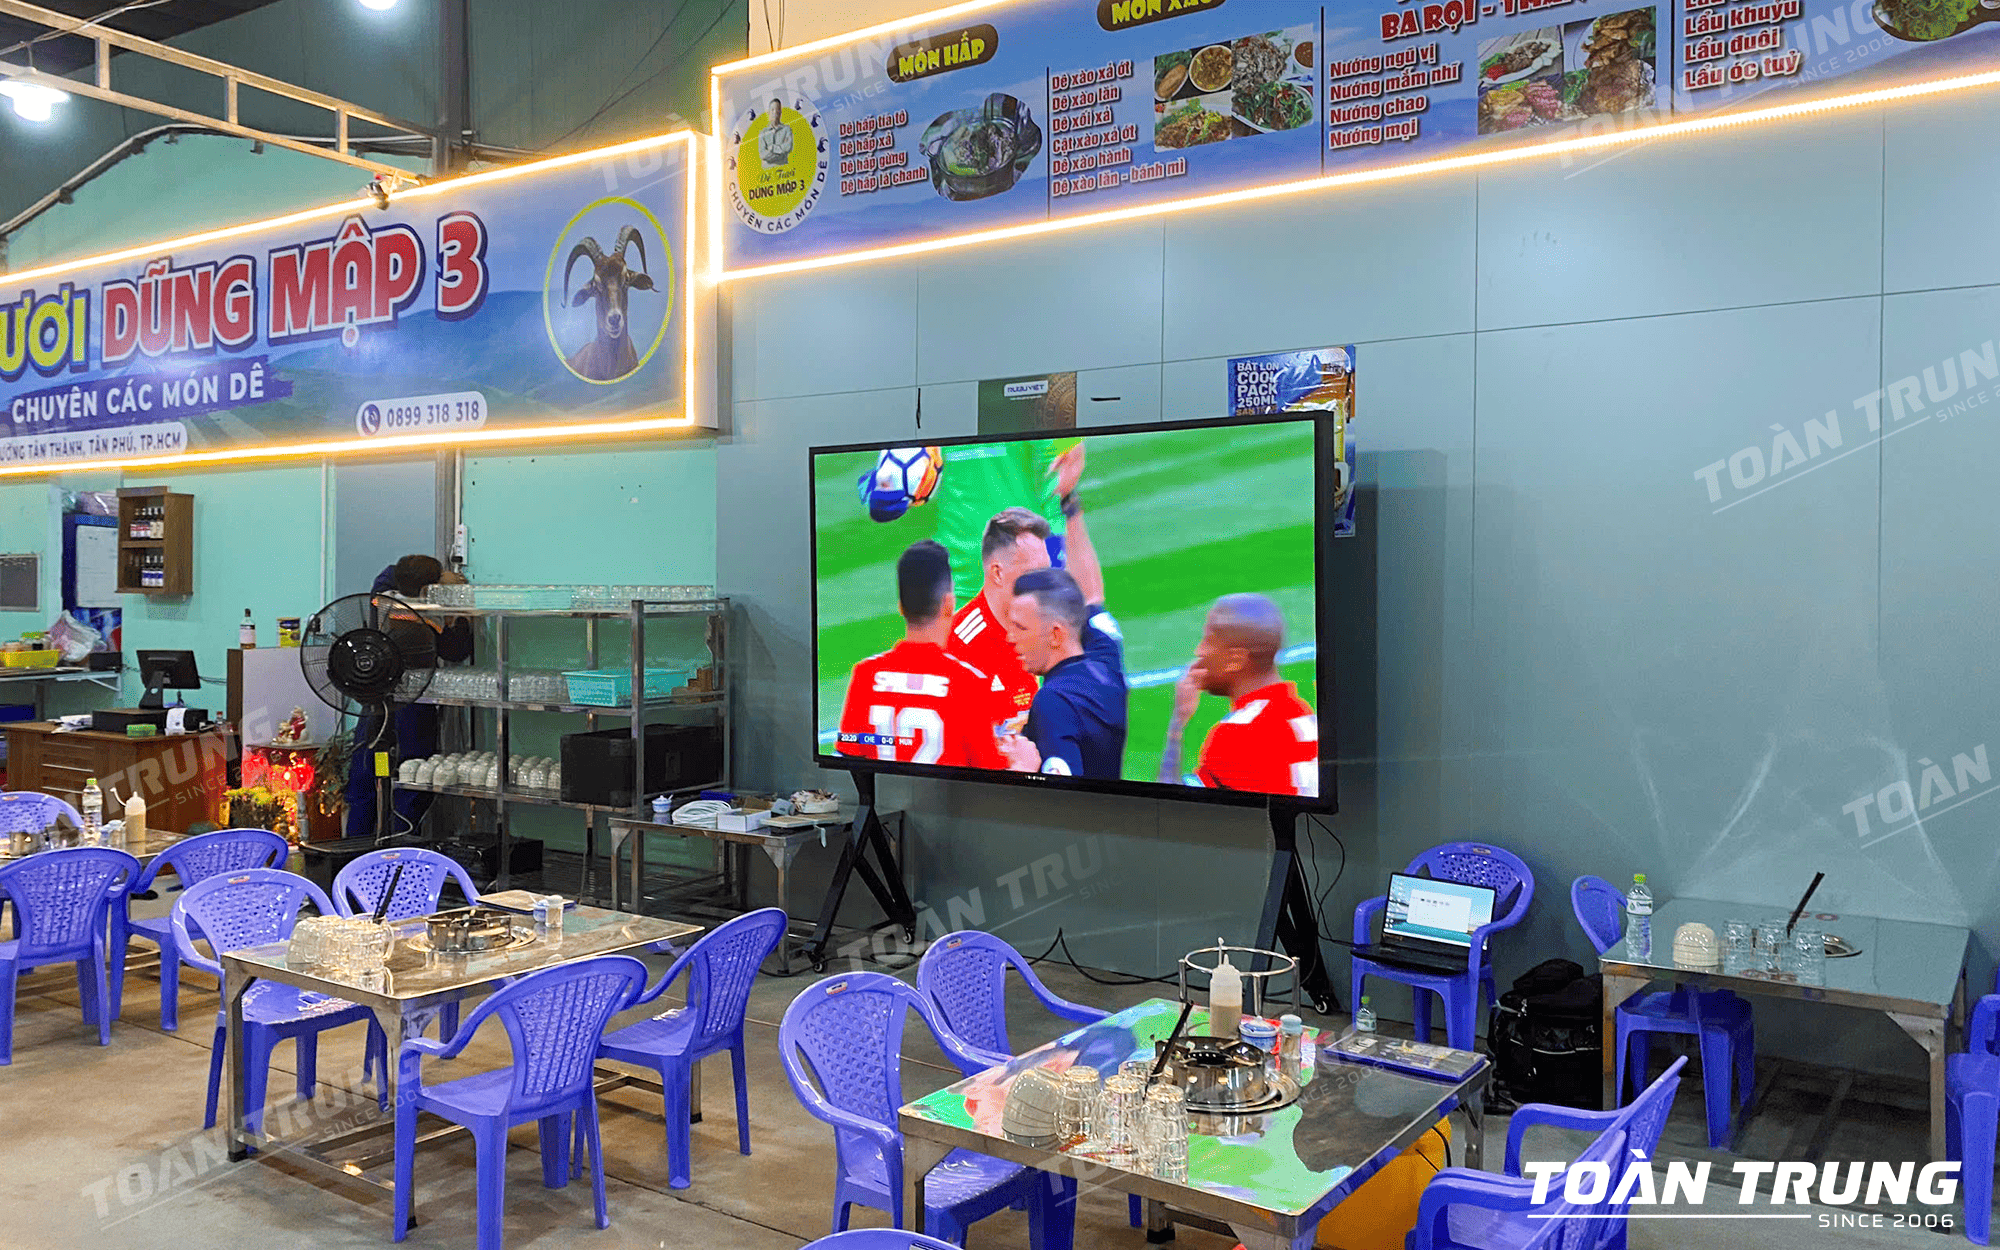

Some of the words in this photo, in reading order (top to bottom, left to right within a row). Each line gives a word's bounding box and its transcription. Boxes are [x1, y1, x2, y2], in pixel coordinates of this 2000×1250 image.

[1381, 10, 1419, 40] BA
[1423, 0, 1476, 31] RỌI
[1685, 10, 1724, 36] Lẩu
[899, 47, 940, 76] MÓN
[944, 30, 985, 66] HẤP
[1685, 36, 1724, 62] Lẩu
[1730, 28, 1779, 55] đuôi
[1684, 63, 1724, 88] Lẩu
[1385, 95, 1426, 116] chao
[892, 166, 926, 184] chanh
[102, 258, 254, 361] DŨNG
[269, 215, 422, 348] MẬP
[438, 215, 483, 313] 3
[12, 386, 98, 424] CHUYÊN
[106, 379, 153, 415] CÁC
[162, 371, 219, 409] MÓN
[229, 362, 264, 401] DÊ
[1237, 383, 1278, 397] PACK
[1237, 394, 1278, 408] 250ML
[386, 408, 421, 428] 0899
[427, 403, 450, 424] 318
[456, 400, 479, 421] 318
[141, 431, 181, 451] TP.HCM
[864, 735, 876, 743] CHE
[881, 736, 894, 745] 0-0
